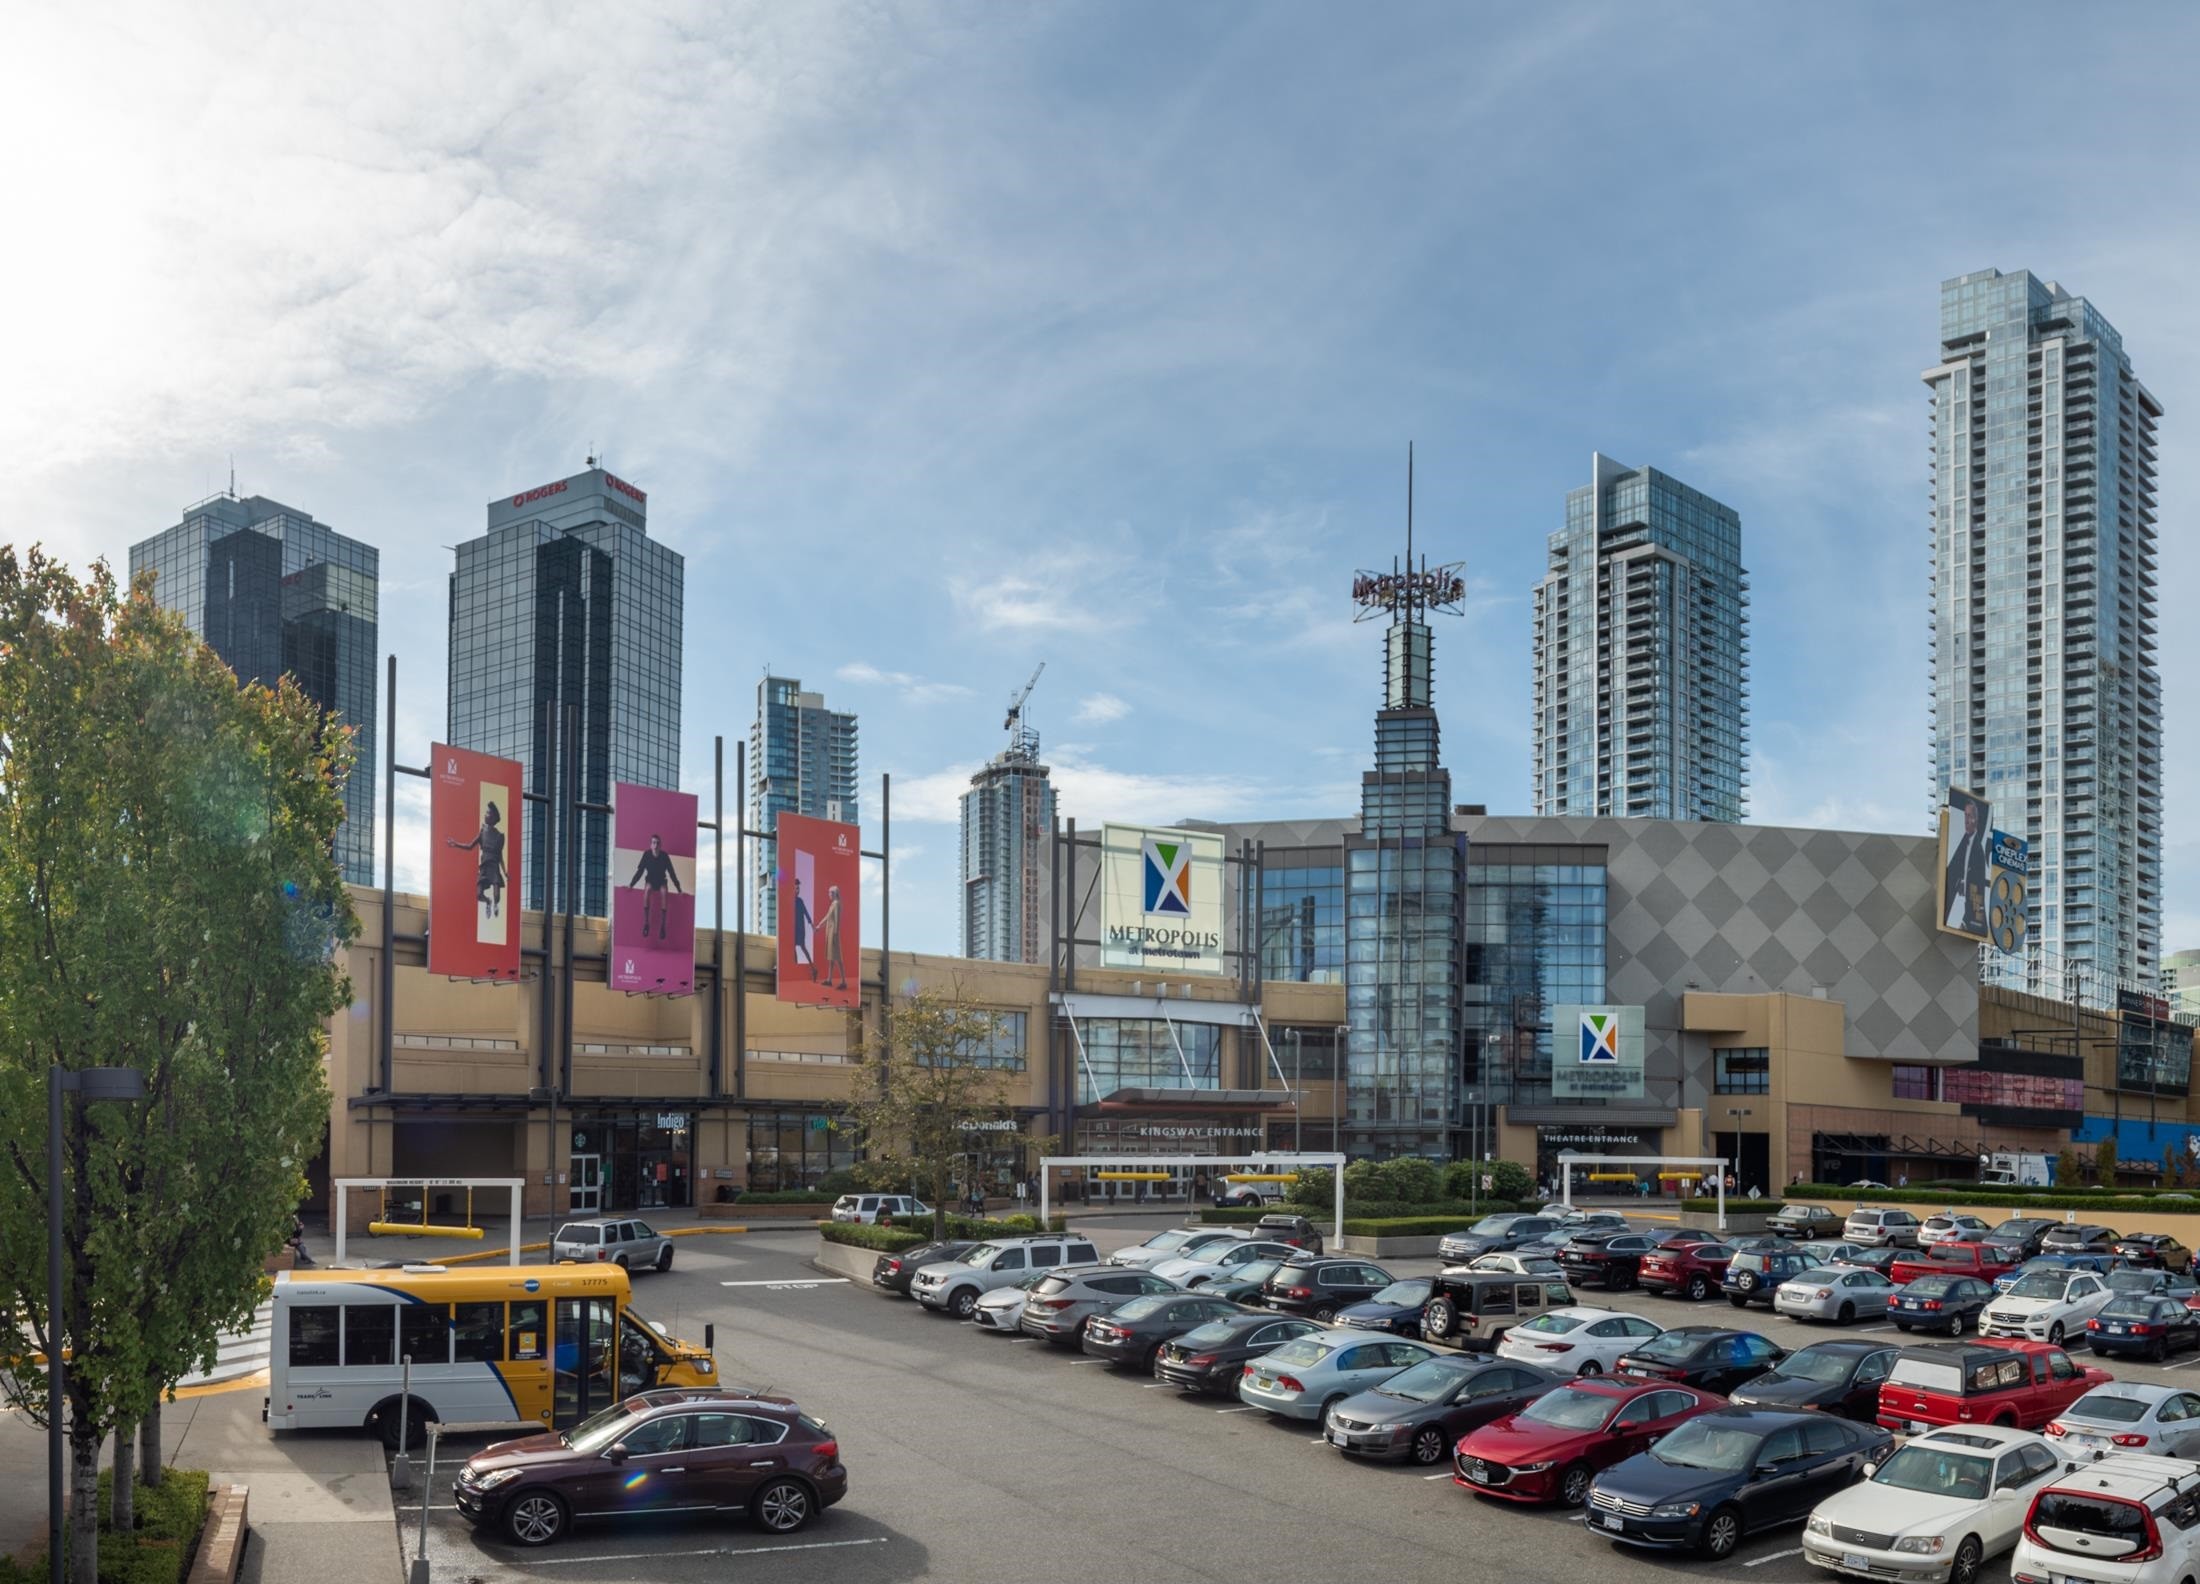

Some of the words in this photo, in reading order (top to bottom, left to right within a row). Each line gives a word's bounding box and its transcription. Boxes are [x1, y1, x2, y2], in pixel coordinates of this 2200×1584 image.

[526, 480, 568, 503] ROGERS
[614, 479, 646, 503] ROGERS
[1995, 844, 2028, 863] CINEPLEX
[1999, 854, 2025, 871] CINEMAS
[1109, 925, 1219, 948] METROPOLIS
[1128, 946, 1139, 955] at
[1142, 947, 1200, 959] metrotown
[1556, 1070, 1640, 1083] METROPOLIS
[1140, 1127, 1201, 1137] KINGSWAY
[1207, 1127, 1264, 1137] ENTRANCE
[1544, 1135, 1586, 1143] THEATRE
[1588, 1135, 1638, 1143] ENTRANCE
